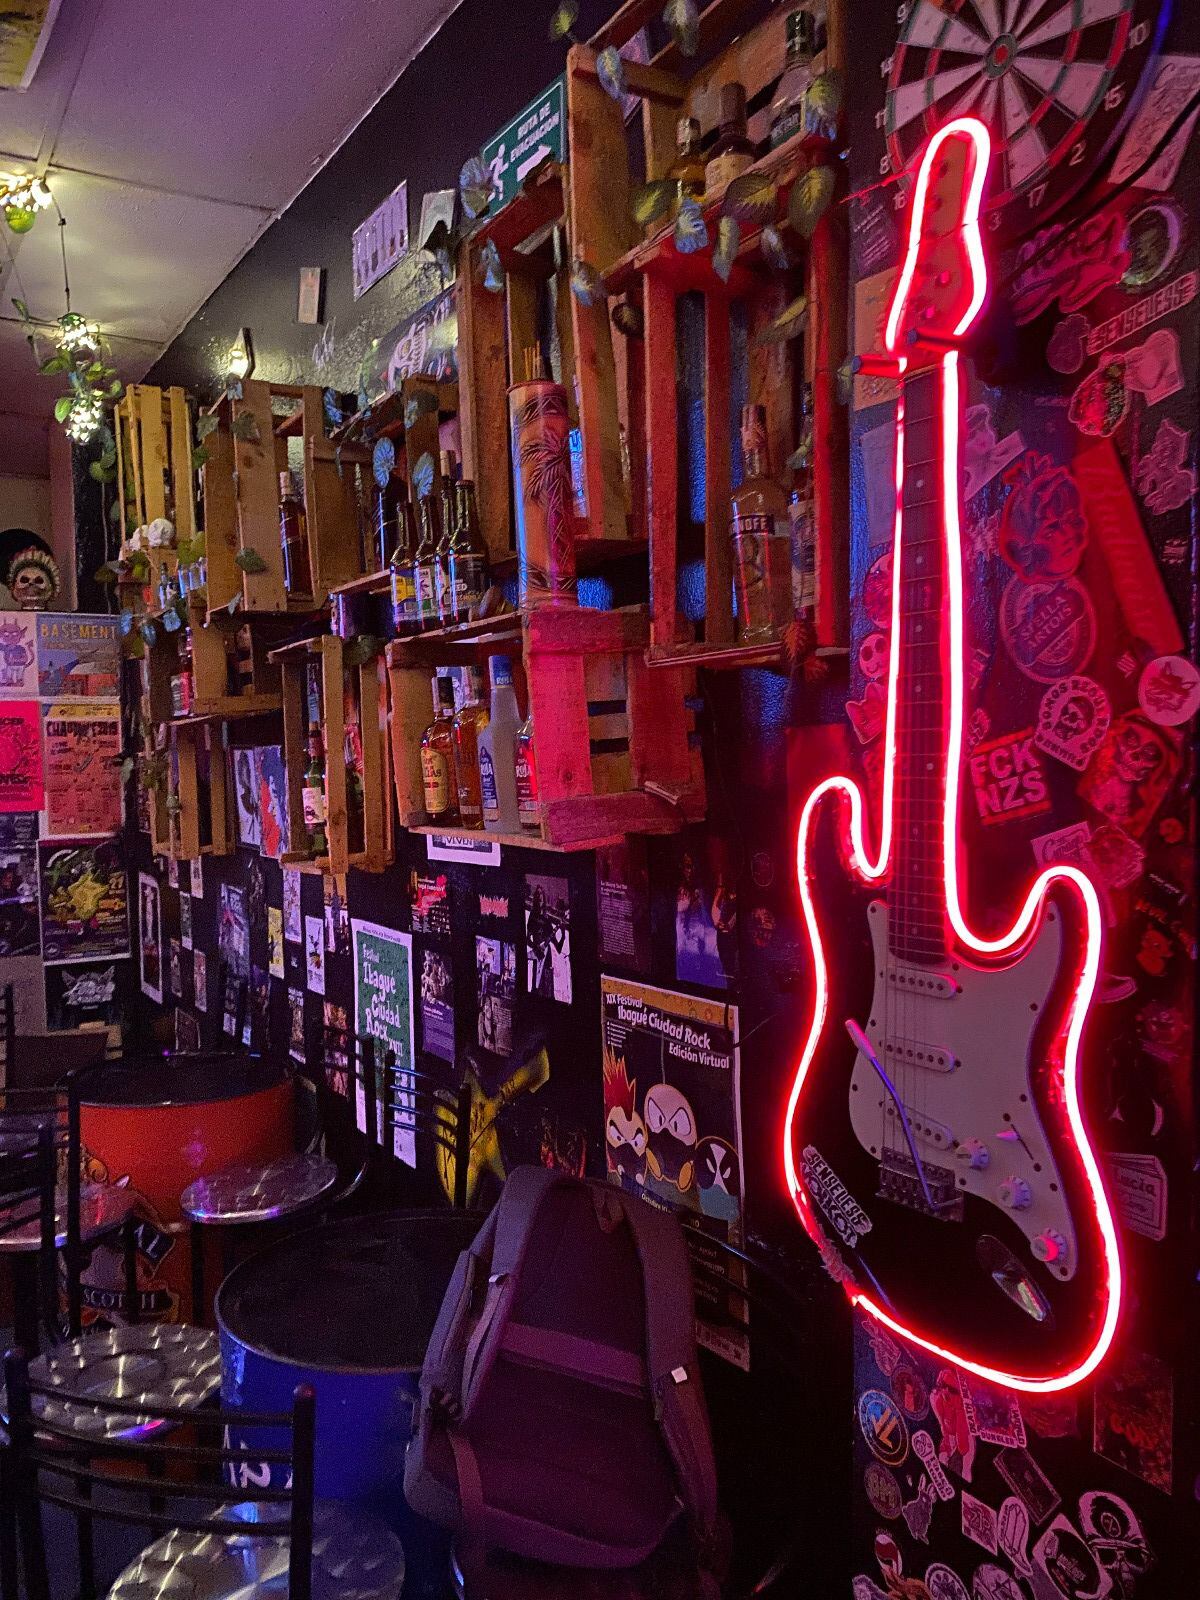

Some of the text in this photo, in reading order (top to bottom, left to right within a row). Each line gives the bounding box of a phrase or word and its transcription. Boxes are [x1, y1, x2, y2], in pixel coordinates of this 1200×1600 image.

[1128, 23, 1150, 48] 10
[1104, 85, 1125, 110] 15
[517, 102, 550, 140] RUTA DE
[880, 156, 890, 174] 8
[1069, 144, 1086, 166] 2
[893, 191, 907, 210] 16
[1028, 190, 1045, 209] 17
[989, 214, 1002, 232] 3
[41, 624, 116, 640] BASEMENT
[1021, 595, 1068, 640] STELLA
[1026, 605, 1072, 648] ARTOIS
[970, 743, 1036, 787] FCK
[976, 772, 1047, 817] NZS
[363, 963, 396, 1001] Ibagué
[371, 996, 400, 1029] Ciudad
[606, 992, 642, 1009] XIX Festival
[366, 1008, 389, 1040] Rock
[618, 1005, 648, 1028] Ibagué
[648, 1012, 683, 1040] Ciudad
[684, 1027, 711, 1050] Rock
[668, 1042, 730, 1069] Edición Virtual
[808, 1153, 865, 1223] SENSELESS
